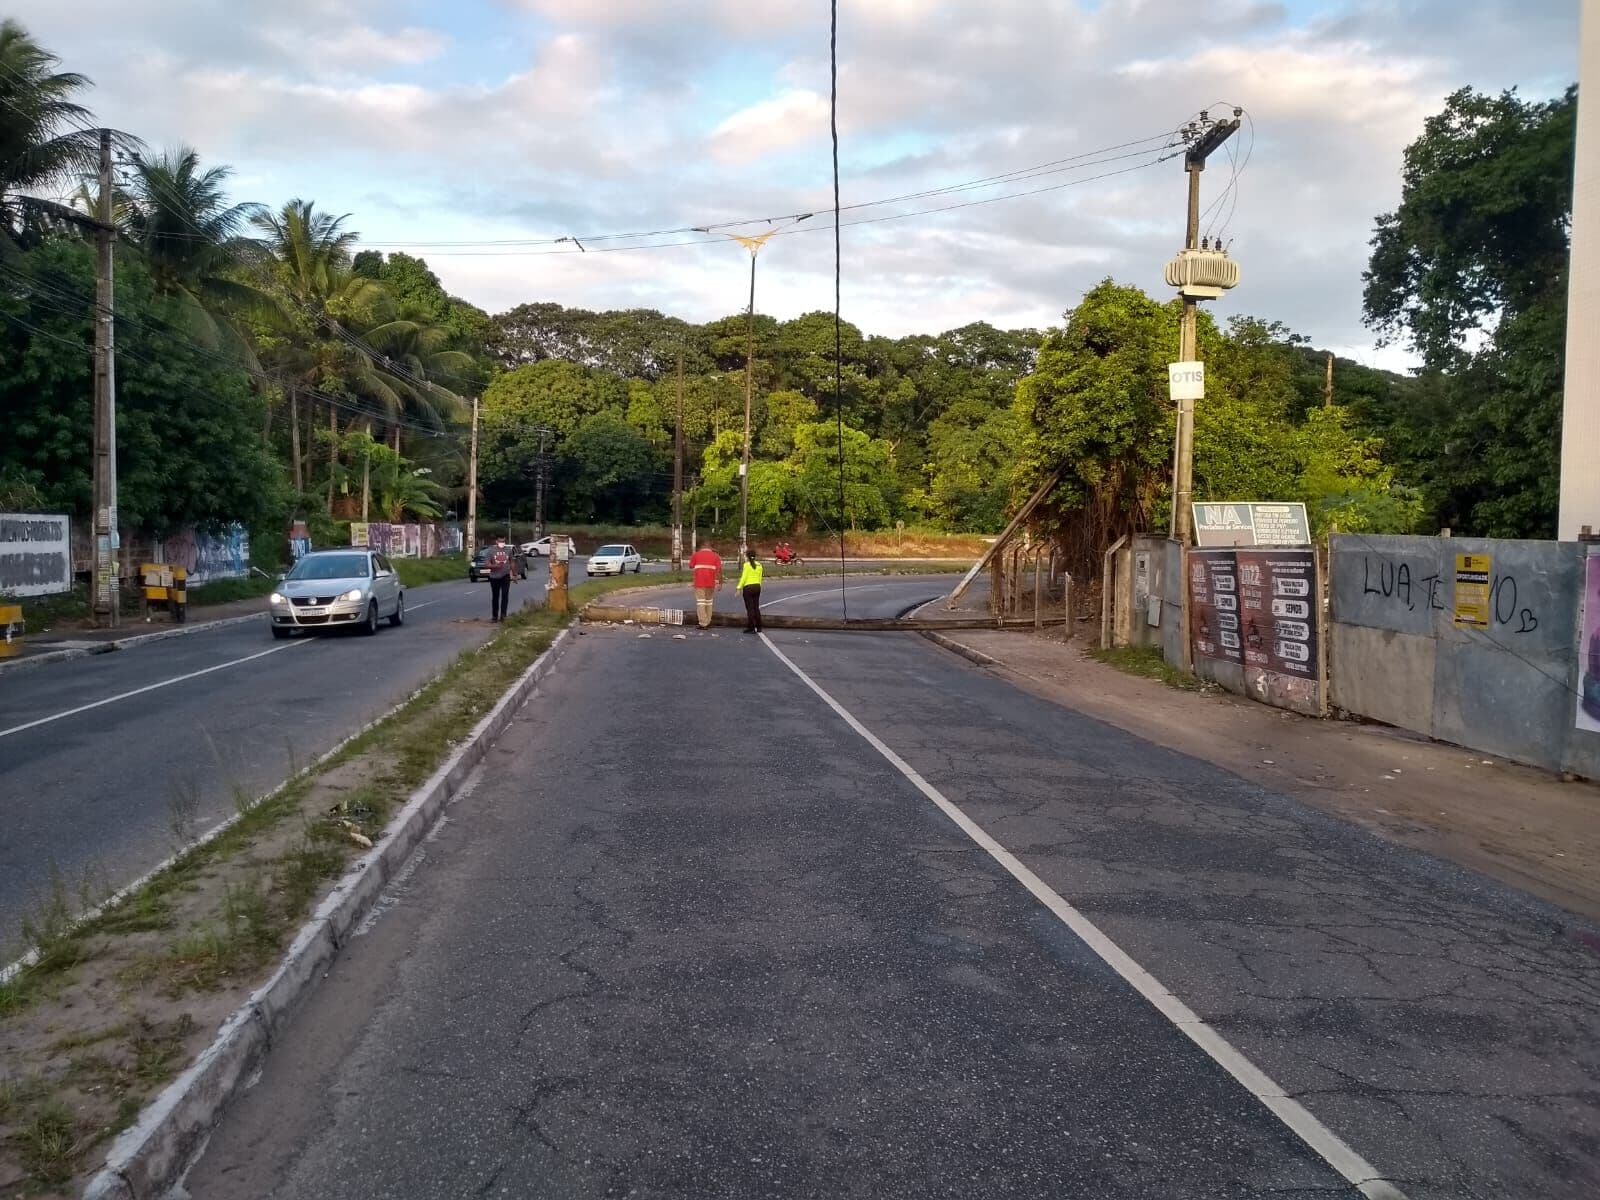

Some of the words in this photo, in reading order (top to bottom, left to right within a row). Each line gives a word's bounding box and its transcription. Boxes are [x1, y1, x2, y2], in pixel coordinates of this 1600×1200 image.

[1172, 371, 1203, 383] OTIS
[1204, 505, 1242, 525] NA
[1364, 556, 1415, 611] LUA,
[1421, 574, 1445, 611] TE
